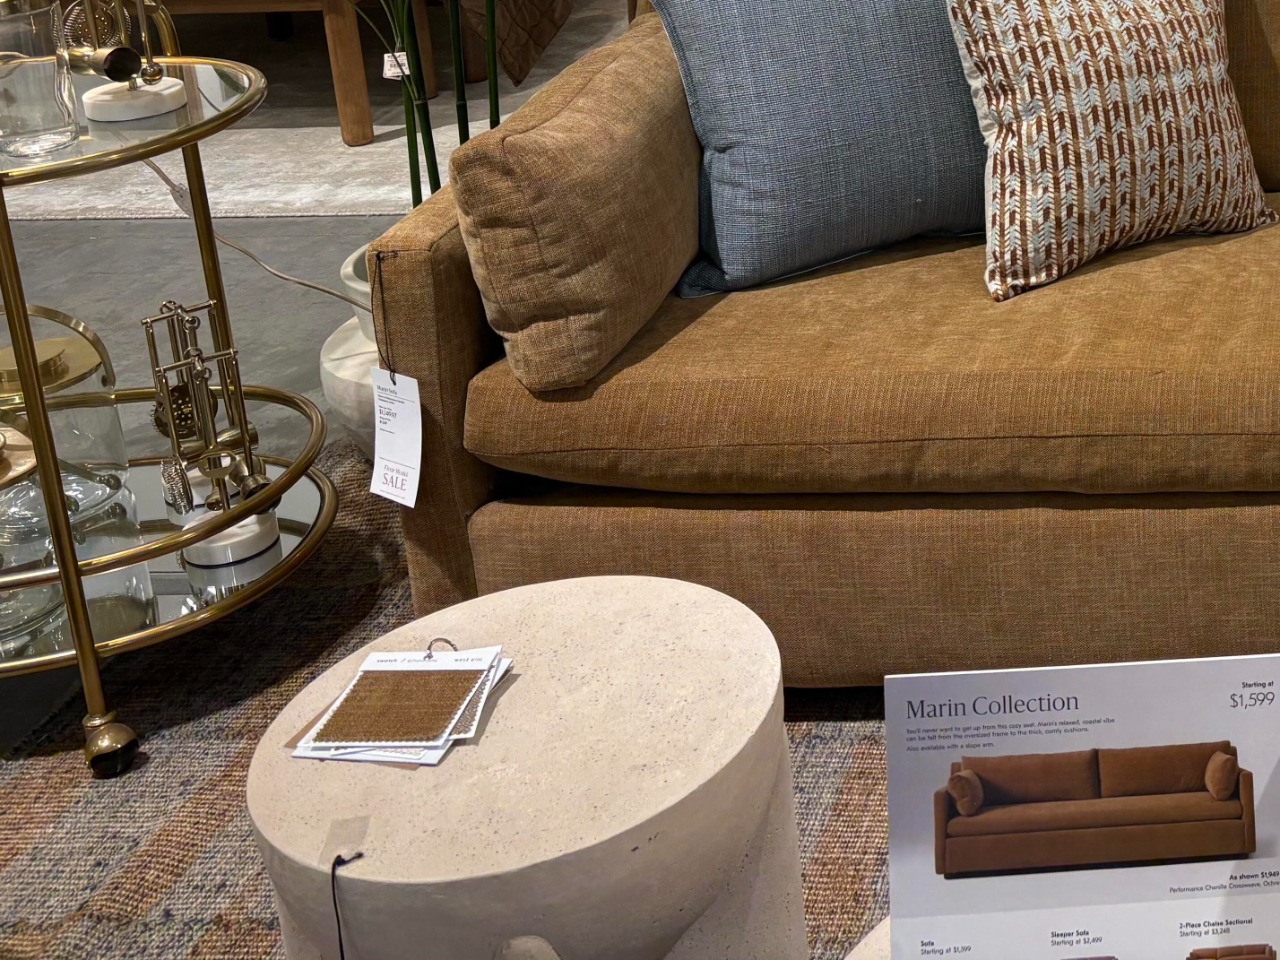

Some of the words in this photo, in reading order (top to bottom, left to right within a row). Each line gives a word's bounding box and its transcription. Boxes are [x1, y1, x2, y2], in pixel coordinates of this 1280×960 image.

[382, 472, 407, 491] SALE
[1242, 681, 1266, 689] Starting
[906, 699, 966, 719] Marin
[973, 693, 1079, 716] Collection
[1230, 691, 1275, 710] $1,599
[1260, 871, 1280, 879] $1,949
